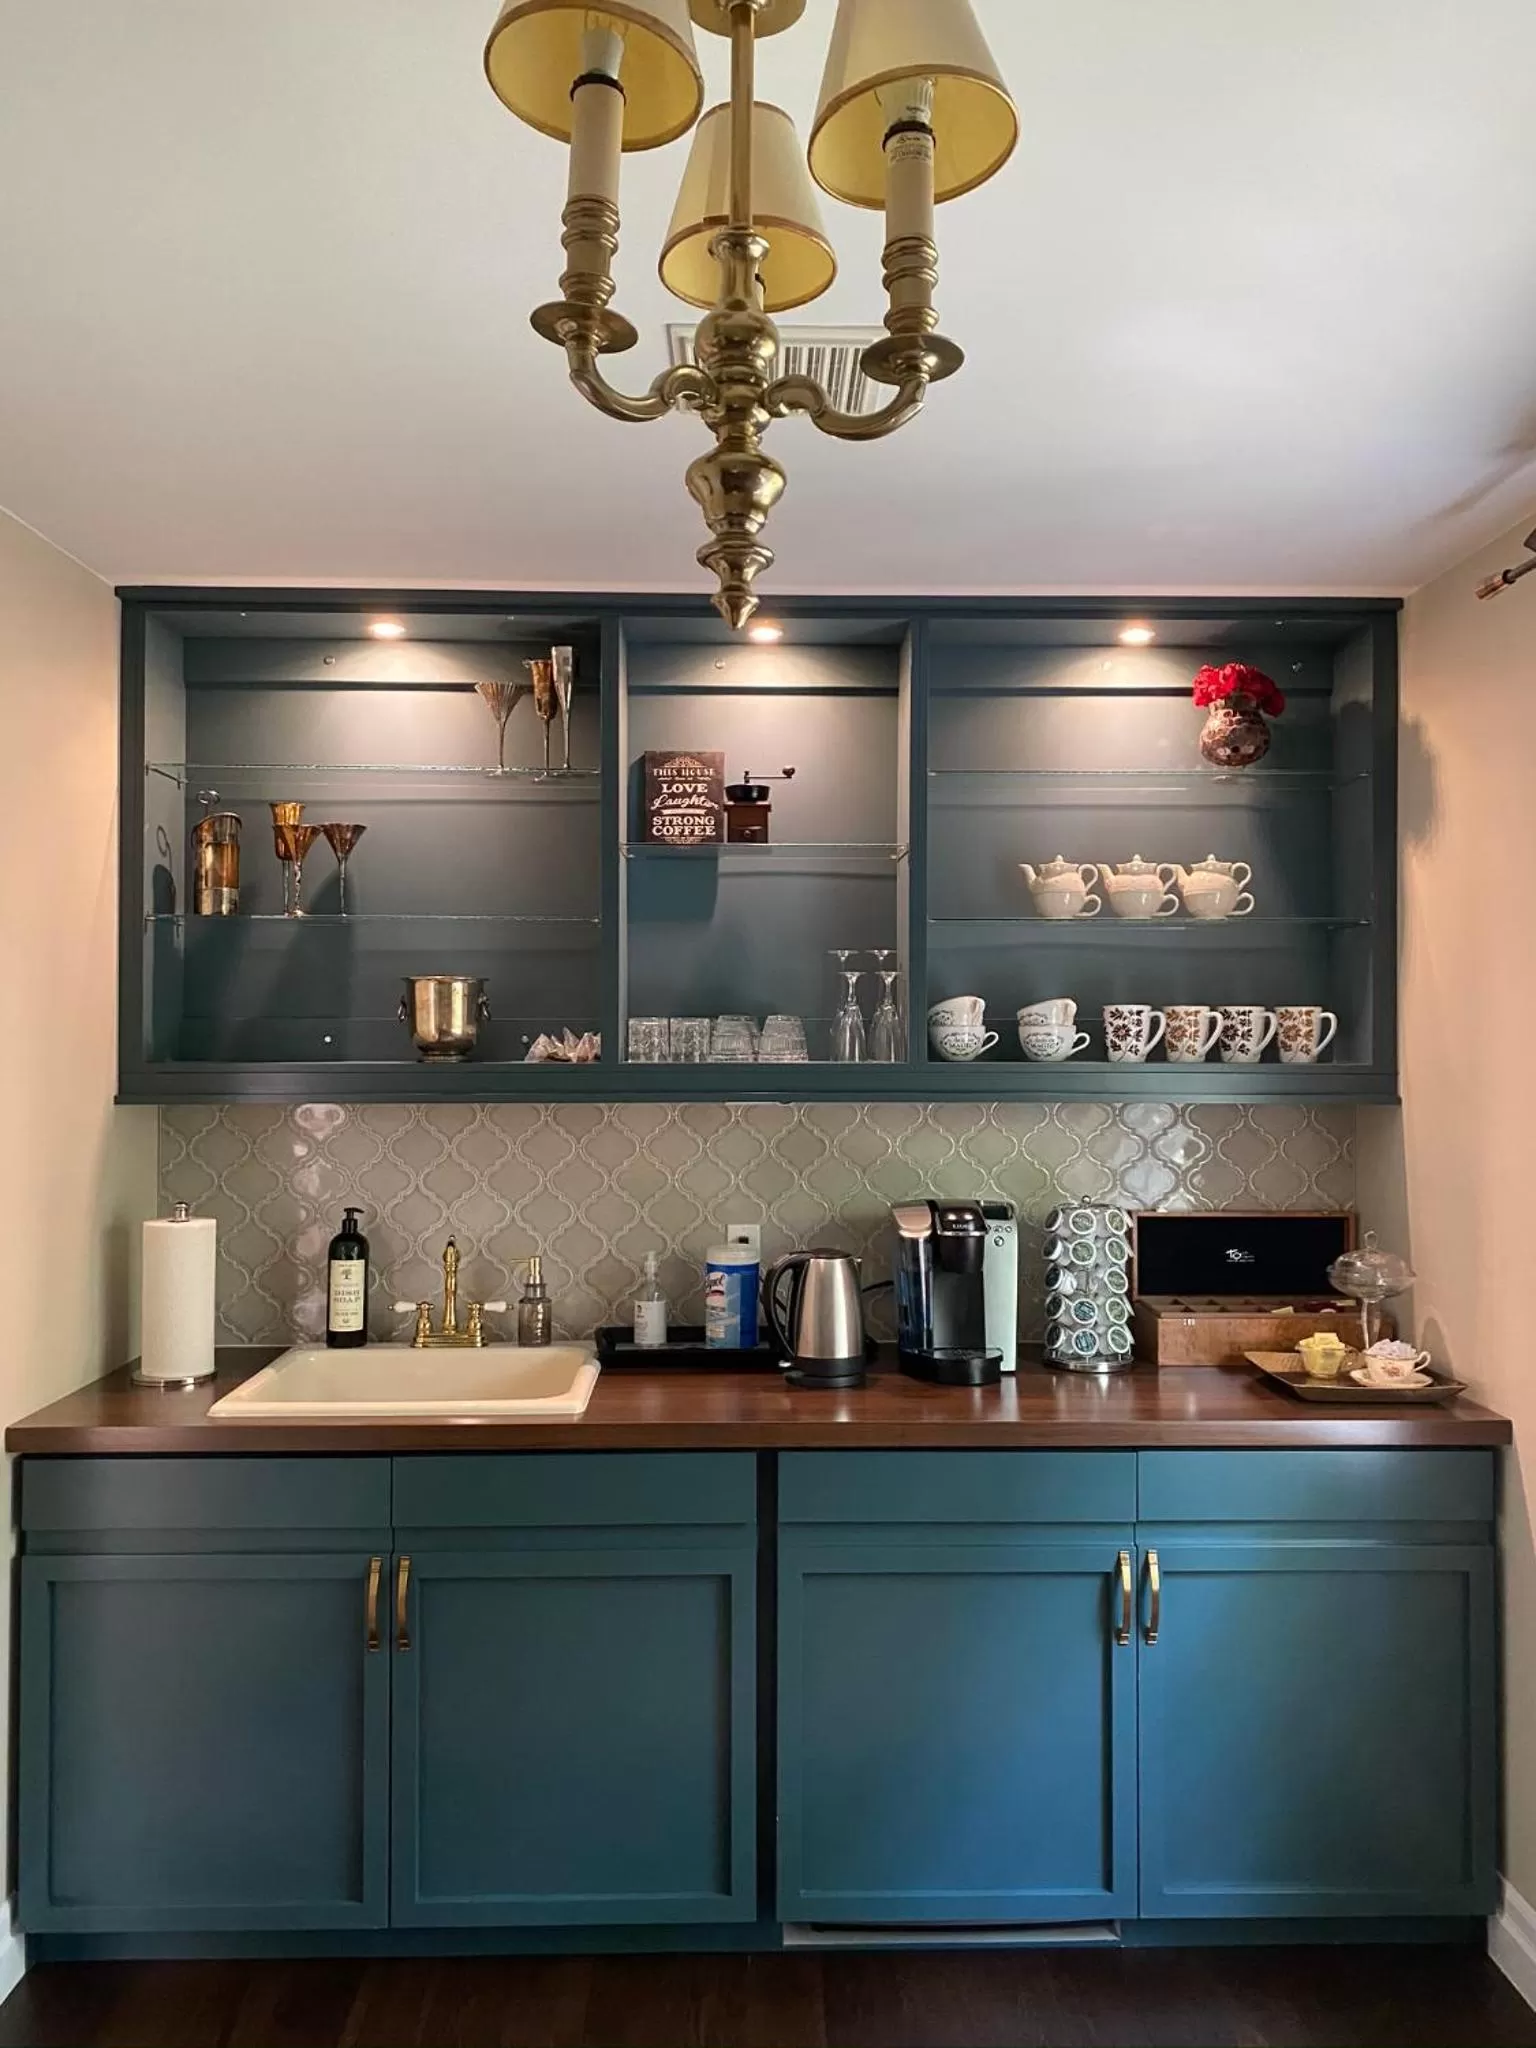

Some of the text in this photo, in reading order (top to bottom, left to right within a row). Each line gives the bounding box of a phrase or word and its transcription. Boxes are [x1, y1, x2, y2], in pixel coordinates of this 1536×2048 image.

[653, 768, 716, 776] THIS HOUSE
[661, 783, 708, 793] LOVE
[650, 794, 719, 810] Laughter
[652, 816, 715, 826] STRONG
[652, 825, 716, 836] COFFEE
